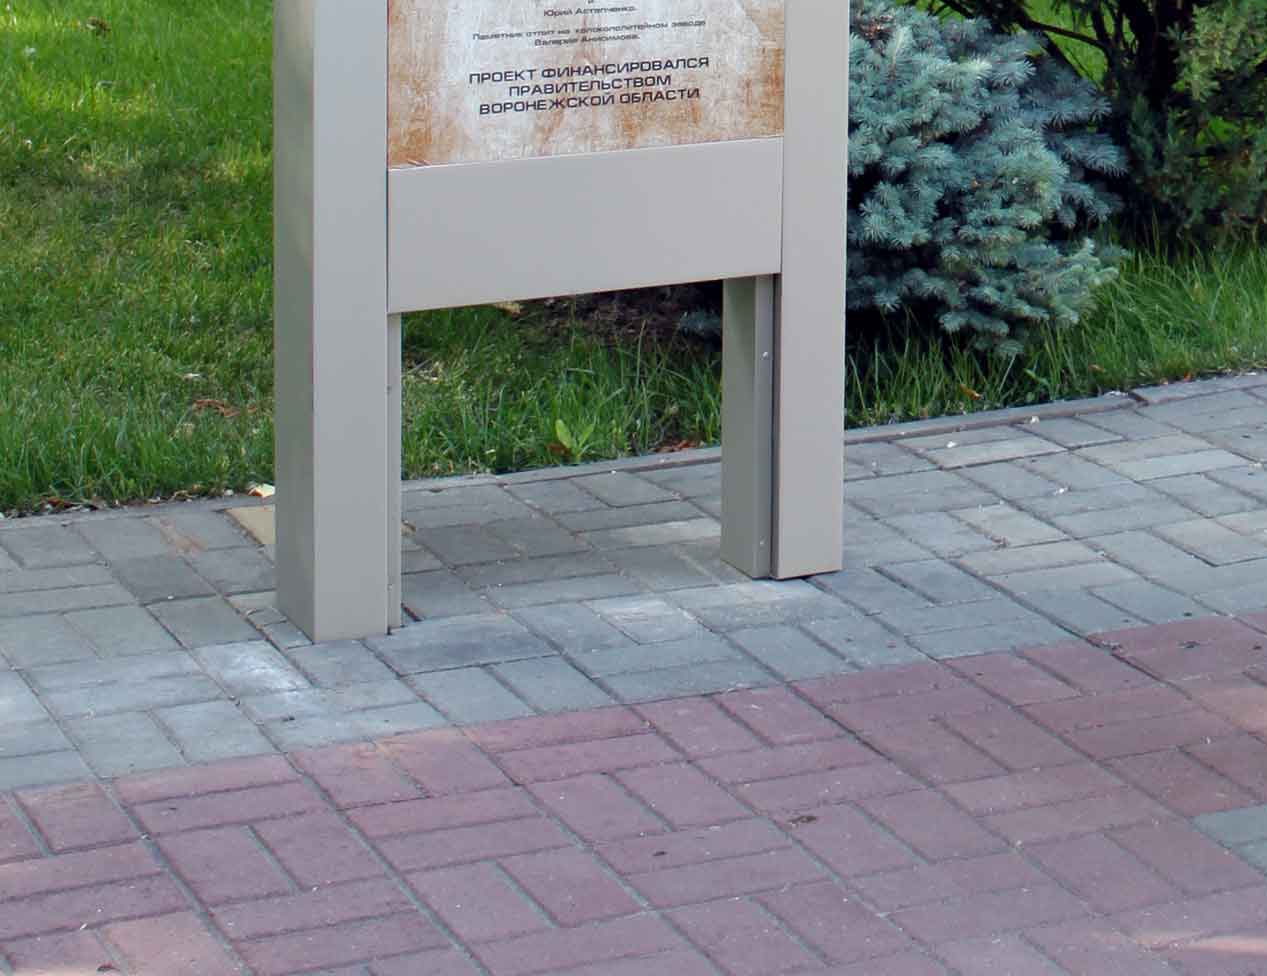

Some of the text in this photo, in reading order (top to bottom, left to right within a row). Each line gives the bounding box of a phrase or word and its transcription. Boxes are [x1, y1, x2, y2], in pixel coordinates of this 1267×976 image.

[544, 8, 572, 17] Юрий
[469, 57, 709, 84] ПРОЕКТ ФИНАНСИРОВАЛСЯ
[509, 75, 672, 97] ПРАВИТЕЛЬСТВОМ
[479, 88, 700, 115] ВОРОНЕЖСКОЙ ОБЛАСТИ
